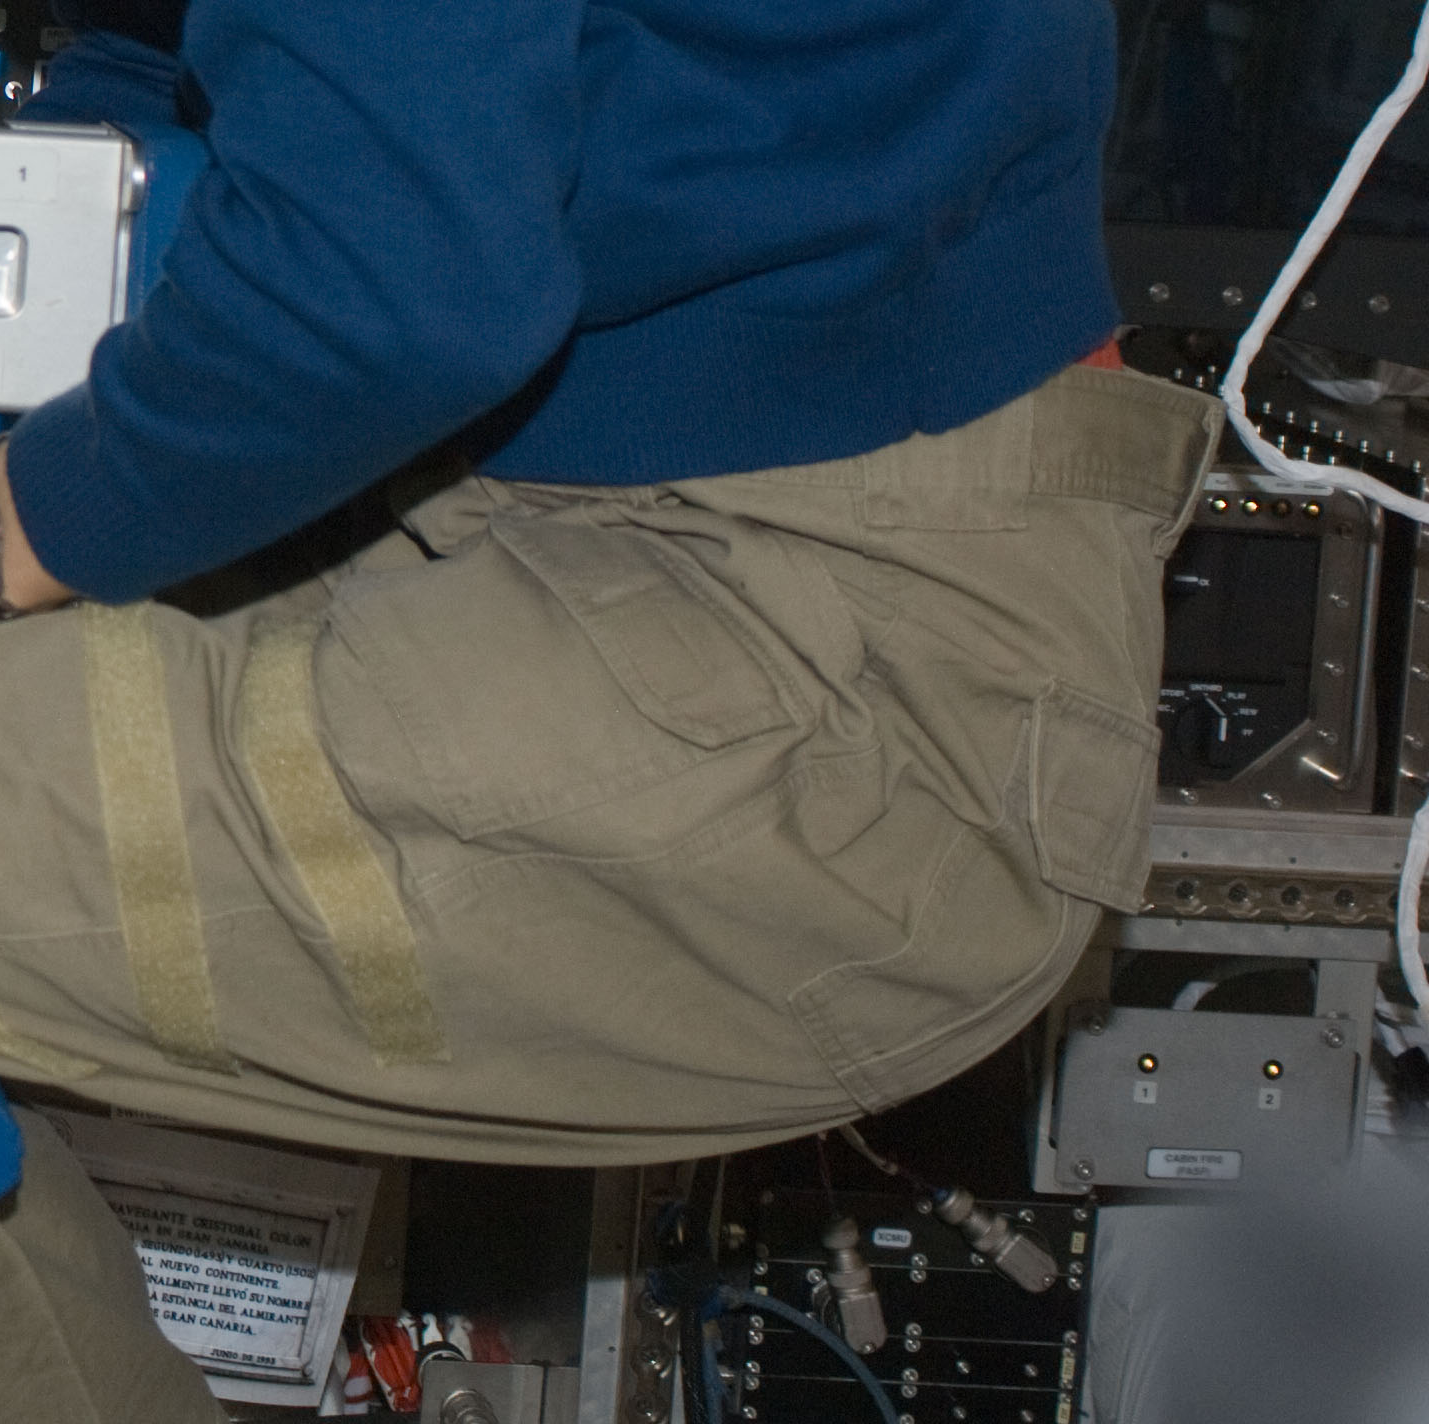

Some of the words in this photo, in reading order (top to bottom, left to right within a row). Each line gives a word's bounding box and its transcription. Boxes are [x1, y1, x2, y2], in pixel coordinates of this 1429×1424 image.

[18, 167, 28, 181] 1
[1142, 1088, 1149, 1098] 1
[1265, 1093, 1274, 1104] 2
[142, 1239, 193, 1257] SEGUNDO
[238, 1257, 285, 1274] CUARTO
[160, 1259, 200, 1275] NUEVO
[162, 1293, 216, 1312] ESTANCIA
[218, 1303, 236, 1315] DEL
[249, 1292, 265, 1304] SU
[163, 1309, 197, 1324] GRAN
[210, 1348, 240, 1360] JUNIO
